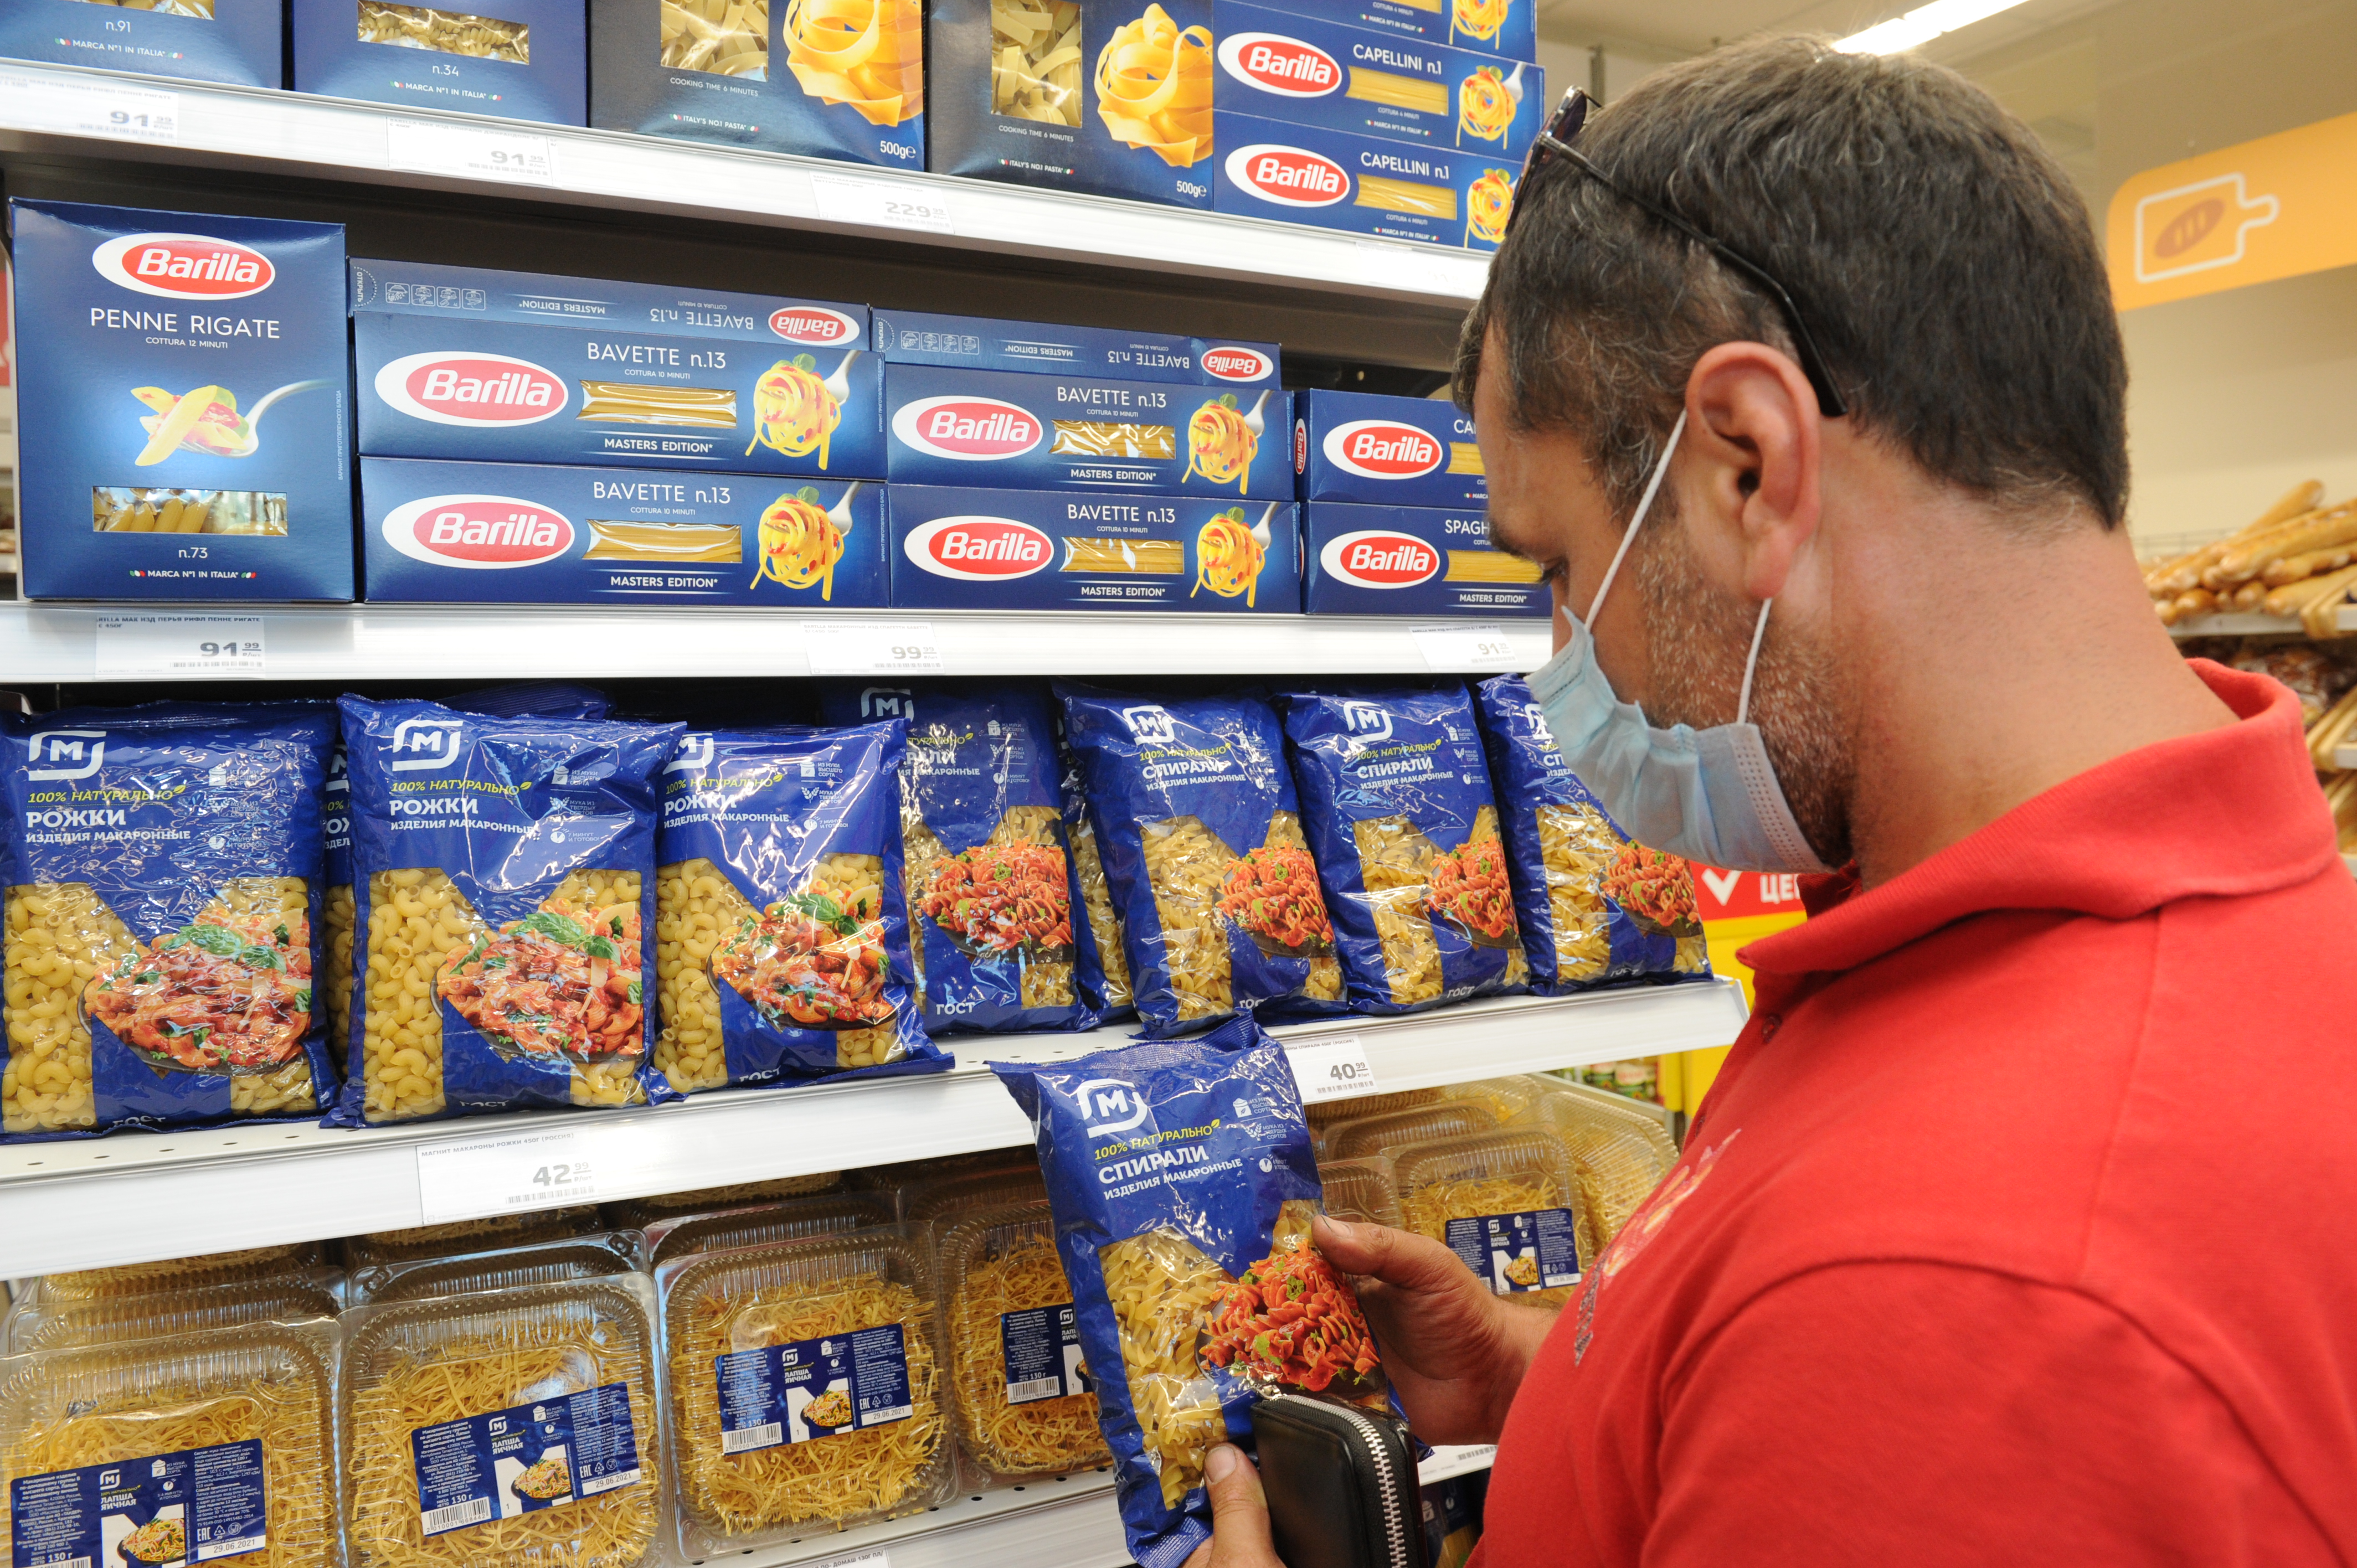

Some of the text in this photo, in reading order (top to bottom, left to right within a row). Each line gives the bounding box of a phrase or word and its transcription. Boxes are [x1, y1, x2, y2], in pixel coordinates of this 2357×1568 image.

[106, 20, 131, 33] n.91
[73, 39, 105, 51] MARCA
[125, 46, 134, 54] IN
[1248, 47, 1331, 85] Barilla
[1354, 44, 1442, 75] CAPELLINI n.1
[433, 64, 459, 77] n.34
[670, 77, 703, 90] COOKING
[706, 82, 721, 91] TIME
[730, 85, 758, 96] MINUTES
[110, 110, 148, 127] 91
[683, 115, 706, 126] ITALY'S
[999, 125, 1027, 135] COOKING
[1029, 129, 1042, 137] TIME
[1049, 133, 1074, 143] MINUTES
[491, 151, 524, 166] 91
[1361, 152, 1449, 180] CAPELLINI n.1
[1255, 158, 1339, 193] Barilla
[885, 202, 931, 218] 229
[137, 249, 260, 282] Barilla
[91, 308, 280, 339] PENNE RIGATE
[650, 308, 753, 330] BAVETTE n.13
[776, 316, 839, 337] Barilla
[146, 337, 186, 347] COTTURA
[199, 341, 228, 349] MINUTI
[588, 343, 726, 369] BAVETTE n.13
[1108, 350, 1190, 369] BAVETTE n.13
[1207, 355, 1257, 374] Barilla
[625, 369, 656, 378] COTTURA
[667, 372, 690, 380] MINUTI
[422, 369, 552, 406] Barilla
[1057, 387, 1166, 408] BAVETTE n.13
[929, 411, 1031, 442] Barilla
[604, 437, 657, 451] MASTERS
[1352, 434, 1432, 463] Barilla
[1071, 469, 1113, 480] MASTERS
[593, 482, 731, 504] BAVETTE n.13
[1068, 504, 1175, 524] BAVETTE n.13
[429, 513, 559, 546] Barilla
[1444, 520, 1490, 535] SPAGH
[178, 547, 208, 559] n.73
[941, 532, 1041, 561] Barilla
[1350, 545, 1430, 572] Barilla
[610, 576, 663, 587] MASTERS
[1081, 587, 1123, 596] MASTERS
[1459, 594, 1493, 604] MASTERS
[200, 642, 237, 657] 91
[891, 646, 922, 659] 99
[1478, 643, 1500, 656] 91
[1139, 746, 1226, 761] 100% НАТУРАЛЬНО
[1357, 743, 1437, 760] 100% НАТУРАЛЬНО
[915, 767, 980, 776] МАКАРОННЫЕ
[1142, 760, 1223, 780] СПИРАЛИ
[1357, 757, 1434, 780] СПИРАЛИ
[390, 780, 519, 796] 100% НАТУРАЛЬНО
[666, 778, 773, 795] 100% НАТУРАЛЬНО
[1146, 774, 1246, 792] ИЗДЕЛИЯ МАКАРОННЫЕ
[1360, 771, 1454, 791] ИЗДЕЛИЯ МАКАРОННЫЕ
[29, 790, 173, 804] 100% НАТУРАЛЬНО
[665, 794, 737, 816] РОЖКИ
[389, 798, 478, 816] РОЖКИ
[26, 809, 126, 829] РОЖКИ
[390, 819, 534, 835] ИЗДЕЛИЯ МАКАРОННЫЕ
[664, 812, 790, 829] ИЗДЕЛИЯ МАКАРОННЫЕ
[25, 830, 191, 844] ИЗДЕЛИЯ МАКАРОННЫЕ
[1447, 985, 1475, 998] ГОСТ
[936, 1003, 975, 1015] ГОСТ
[739, 1067, 780, 1084] ГОСТ
[1330, 1063, 1357, 1081] 40
[421, 1148, 451, 1157] МАГНИТ
[453, 1142, 495, 1153] МАКАРОНЫ
[496, 1139, 522, 1147] РОЖКИ
[541, 1133, 574, 1143] (РОССИЯ)
[1094, 1125, 1213, 1160] 100% НАТУРАЛЬНО
[1098, 1145, 1209, 1185] СПИРАЛИ
[532, 1162, 589, 1187] 42 99
[1103, 1158, 1243, 1200] ИЗДЕЛИЯ МАКАРОННЫЕ
[873, 1407, 905, 1420] 29.06.2021
[492, 1437, 521, 1449] ЛАПША
[493, 1442, 523, 1455] ЯИЧНАЯ
[595, 1472, 632, 1489] 29.06.2021
[101, 1493, 133, 1504] ЛАПША
[101, 1499, 137, 1511] ЯИЧНАЯ
[451, 1494, 467, 1505] 130
[213, 1539, 255, 1554] 29.06.2021
[48, 1552, 66, 1563] 130
